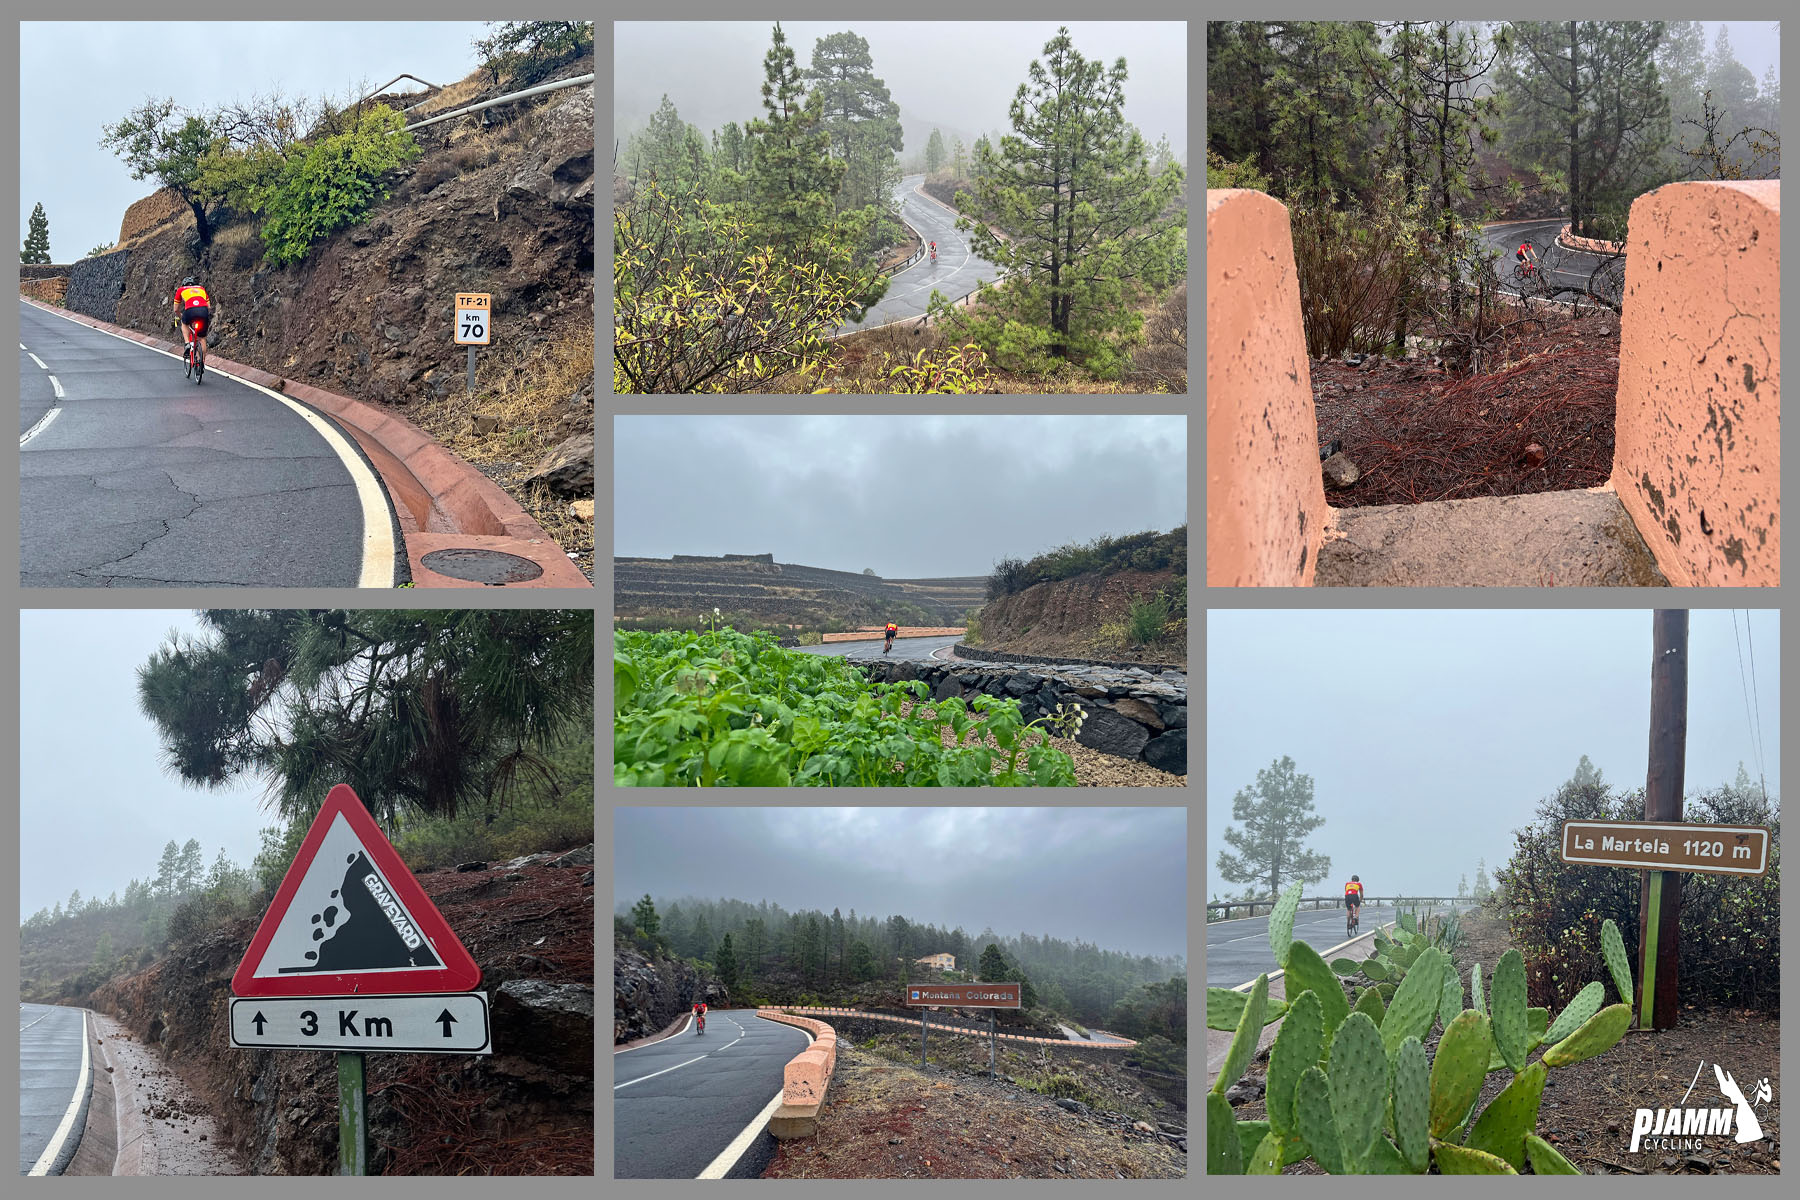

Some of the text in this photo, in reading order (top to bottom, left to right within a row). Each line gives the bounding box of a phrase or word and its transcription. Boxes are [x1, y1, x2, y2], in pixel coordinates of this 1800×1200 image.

[460, 297, 487, 306] TF-21
[465, 313, 480, 322] km
[461, 324, 484, 338] 70
[1574, 834, 1751, 859] La Martela 1120 m
[364, 873, 421, 949] GRAVEYARD
[922, 990, 1014, 1000] Montaña Colorada
[300, 1010, 393, 1037] 3 Km
